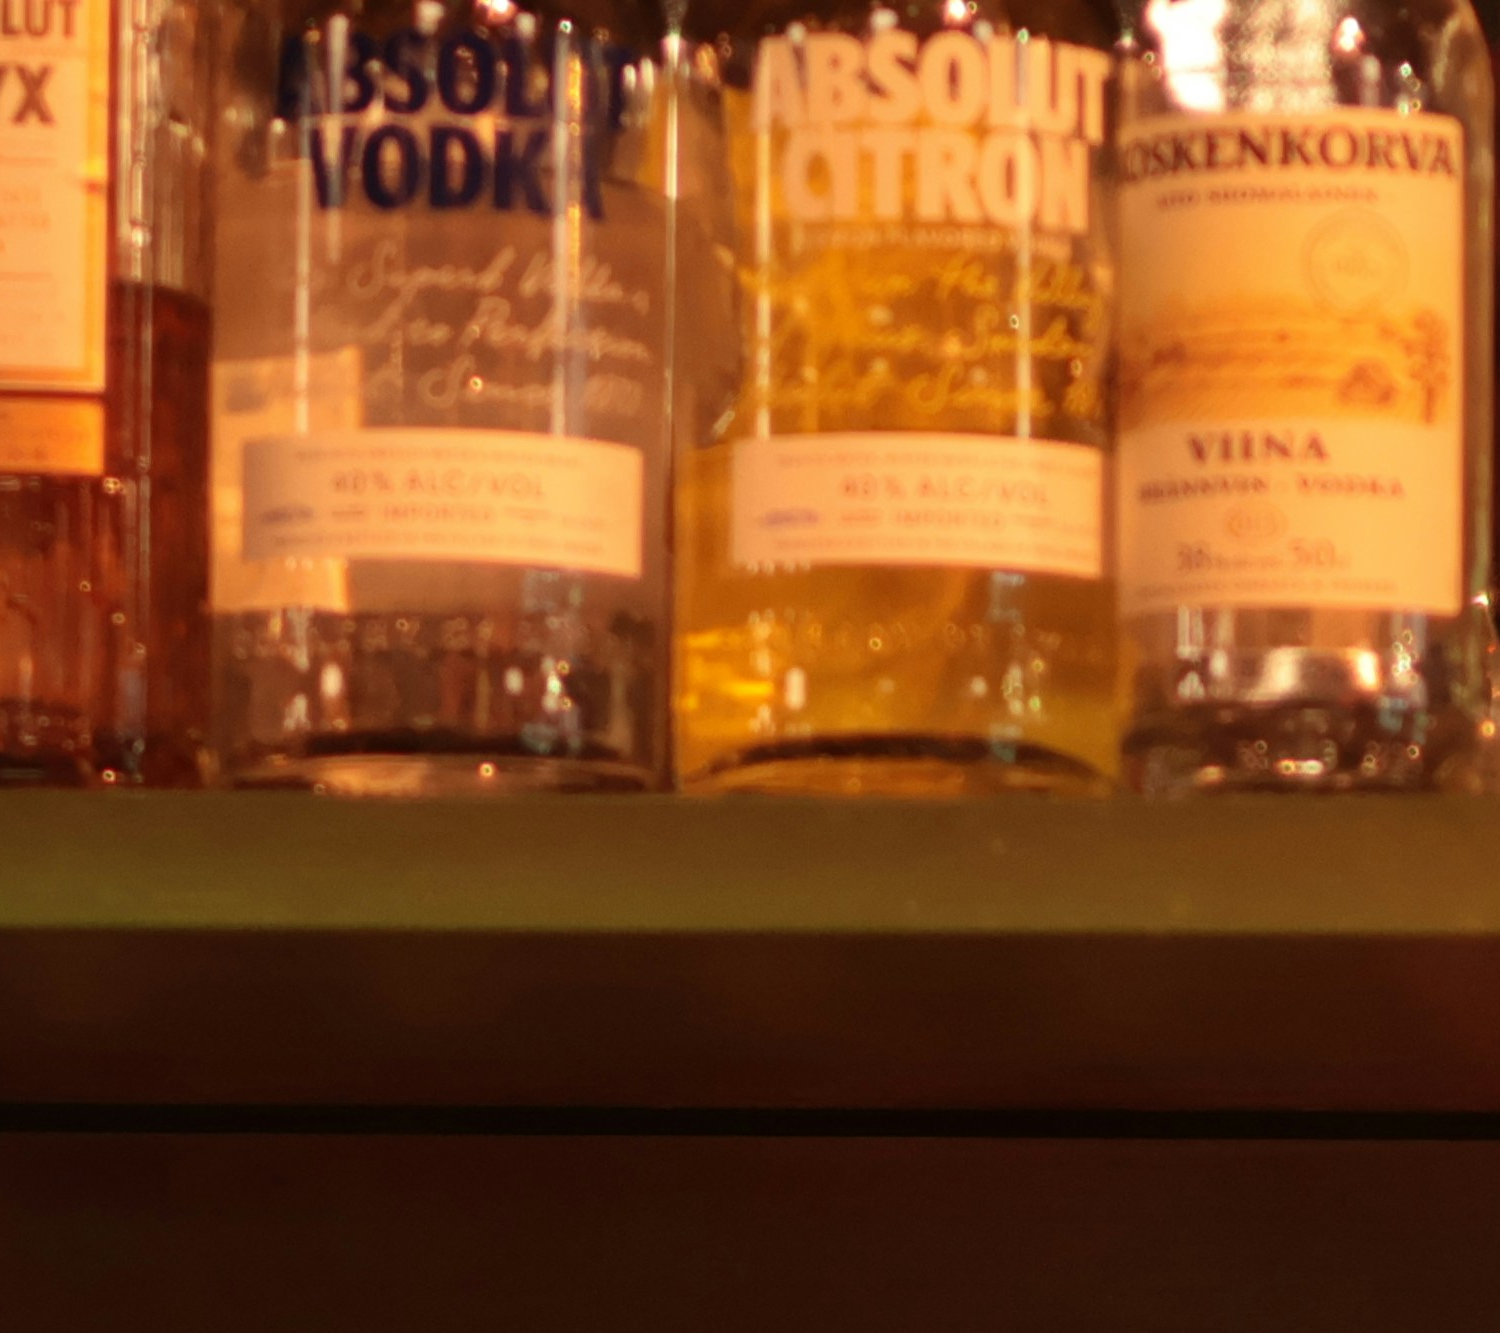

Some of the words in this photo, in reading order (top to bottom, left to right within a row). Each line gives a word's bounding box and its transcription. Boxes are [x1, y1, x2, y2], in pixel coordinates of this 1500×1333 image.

[752, 27, 1112, 146] ABSOLUT
[783, 132, 1091, 236] CITRON
[1122, 127, 1459, 183] OSKENKORVA
[1186, 431, 1331, 466] VIINA
